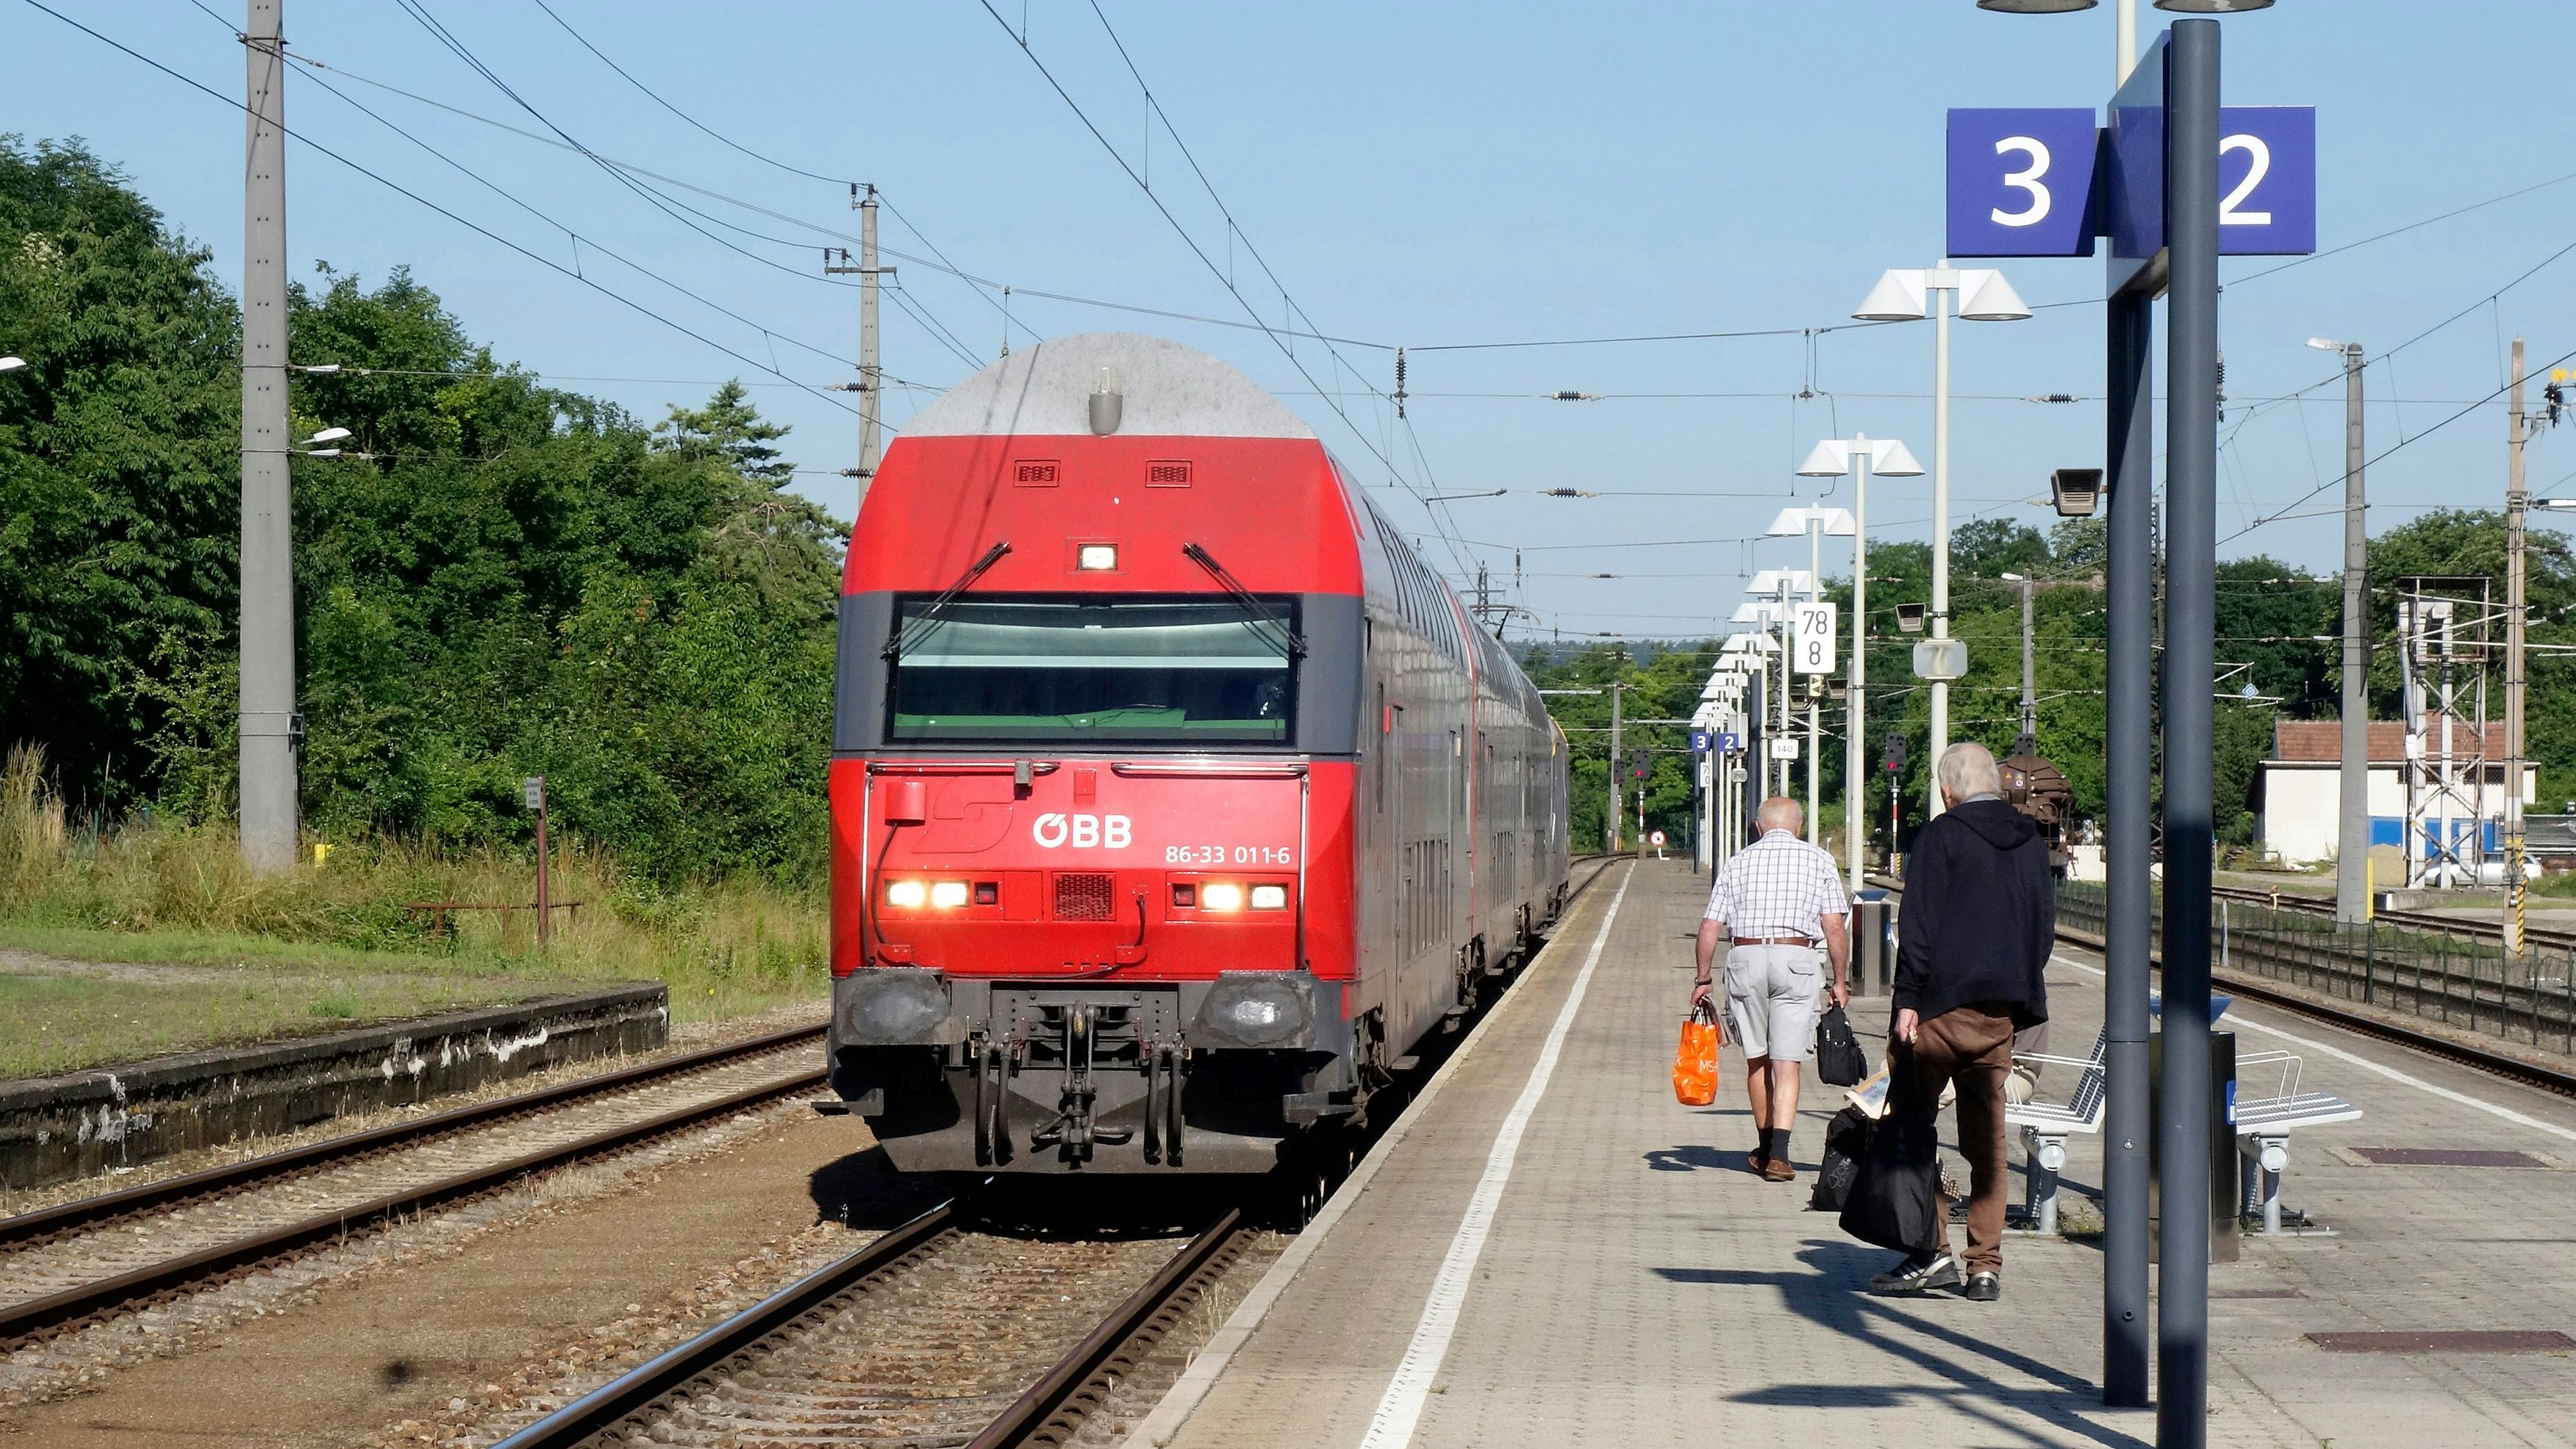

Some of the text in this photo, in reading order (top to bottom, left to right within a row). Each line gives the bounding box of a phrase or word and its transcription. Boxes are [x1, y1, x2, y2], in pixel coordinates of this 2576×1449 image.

[1991, 136, 2051, 227] 3
[2219, 134, 2272, 225] 2
[1803, 610, 1828, 634] 78
[1809, 641, 1821, 665] 8
[1697, 735, 1706, 749] 3
[1724, 736, 1734, 749] 2
[1032, 812, 1132, 848] ÖBB
[1164, 845, 1290, 864] 86-33 011-6
